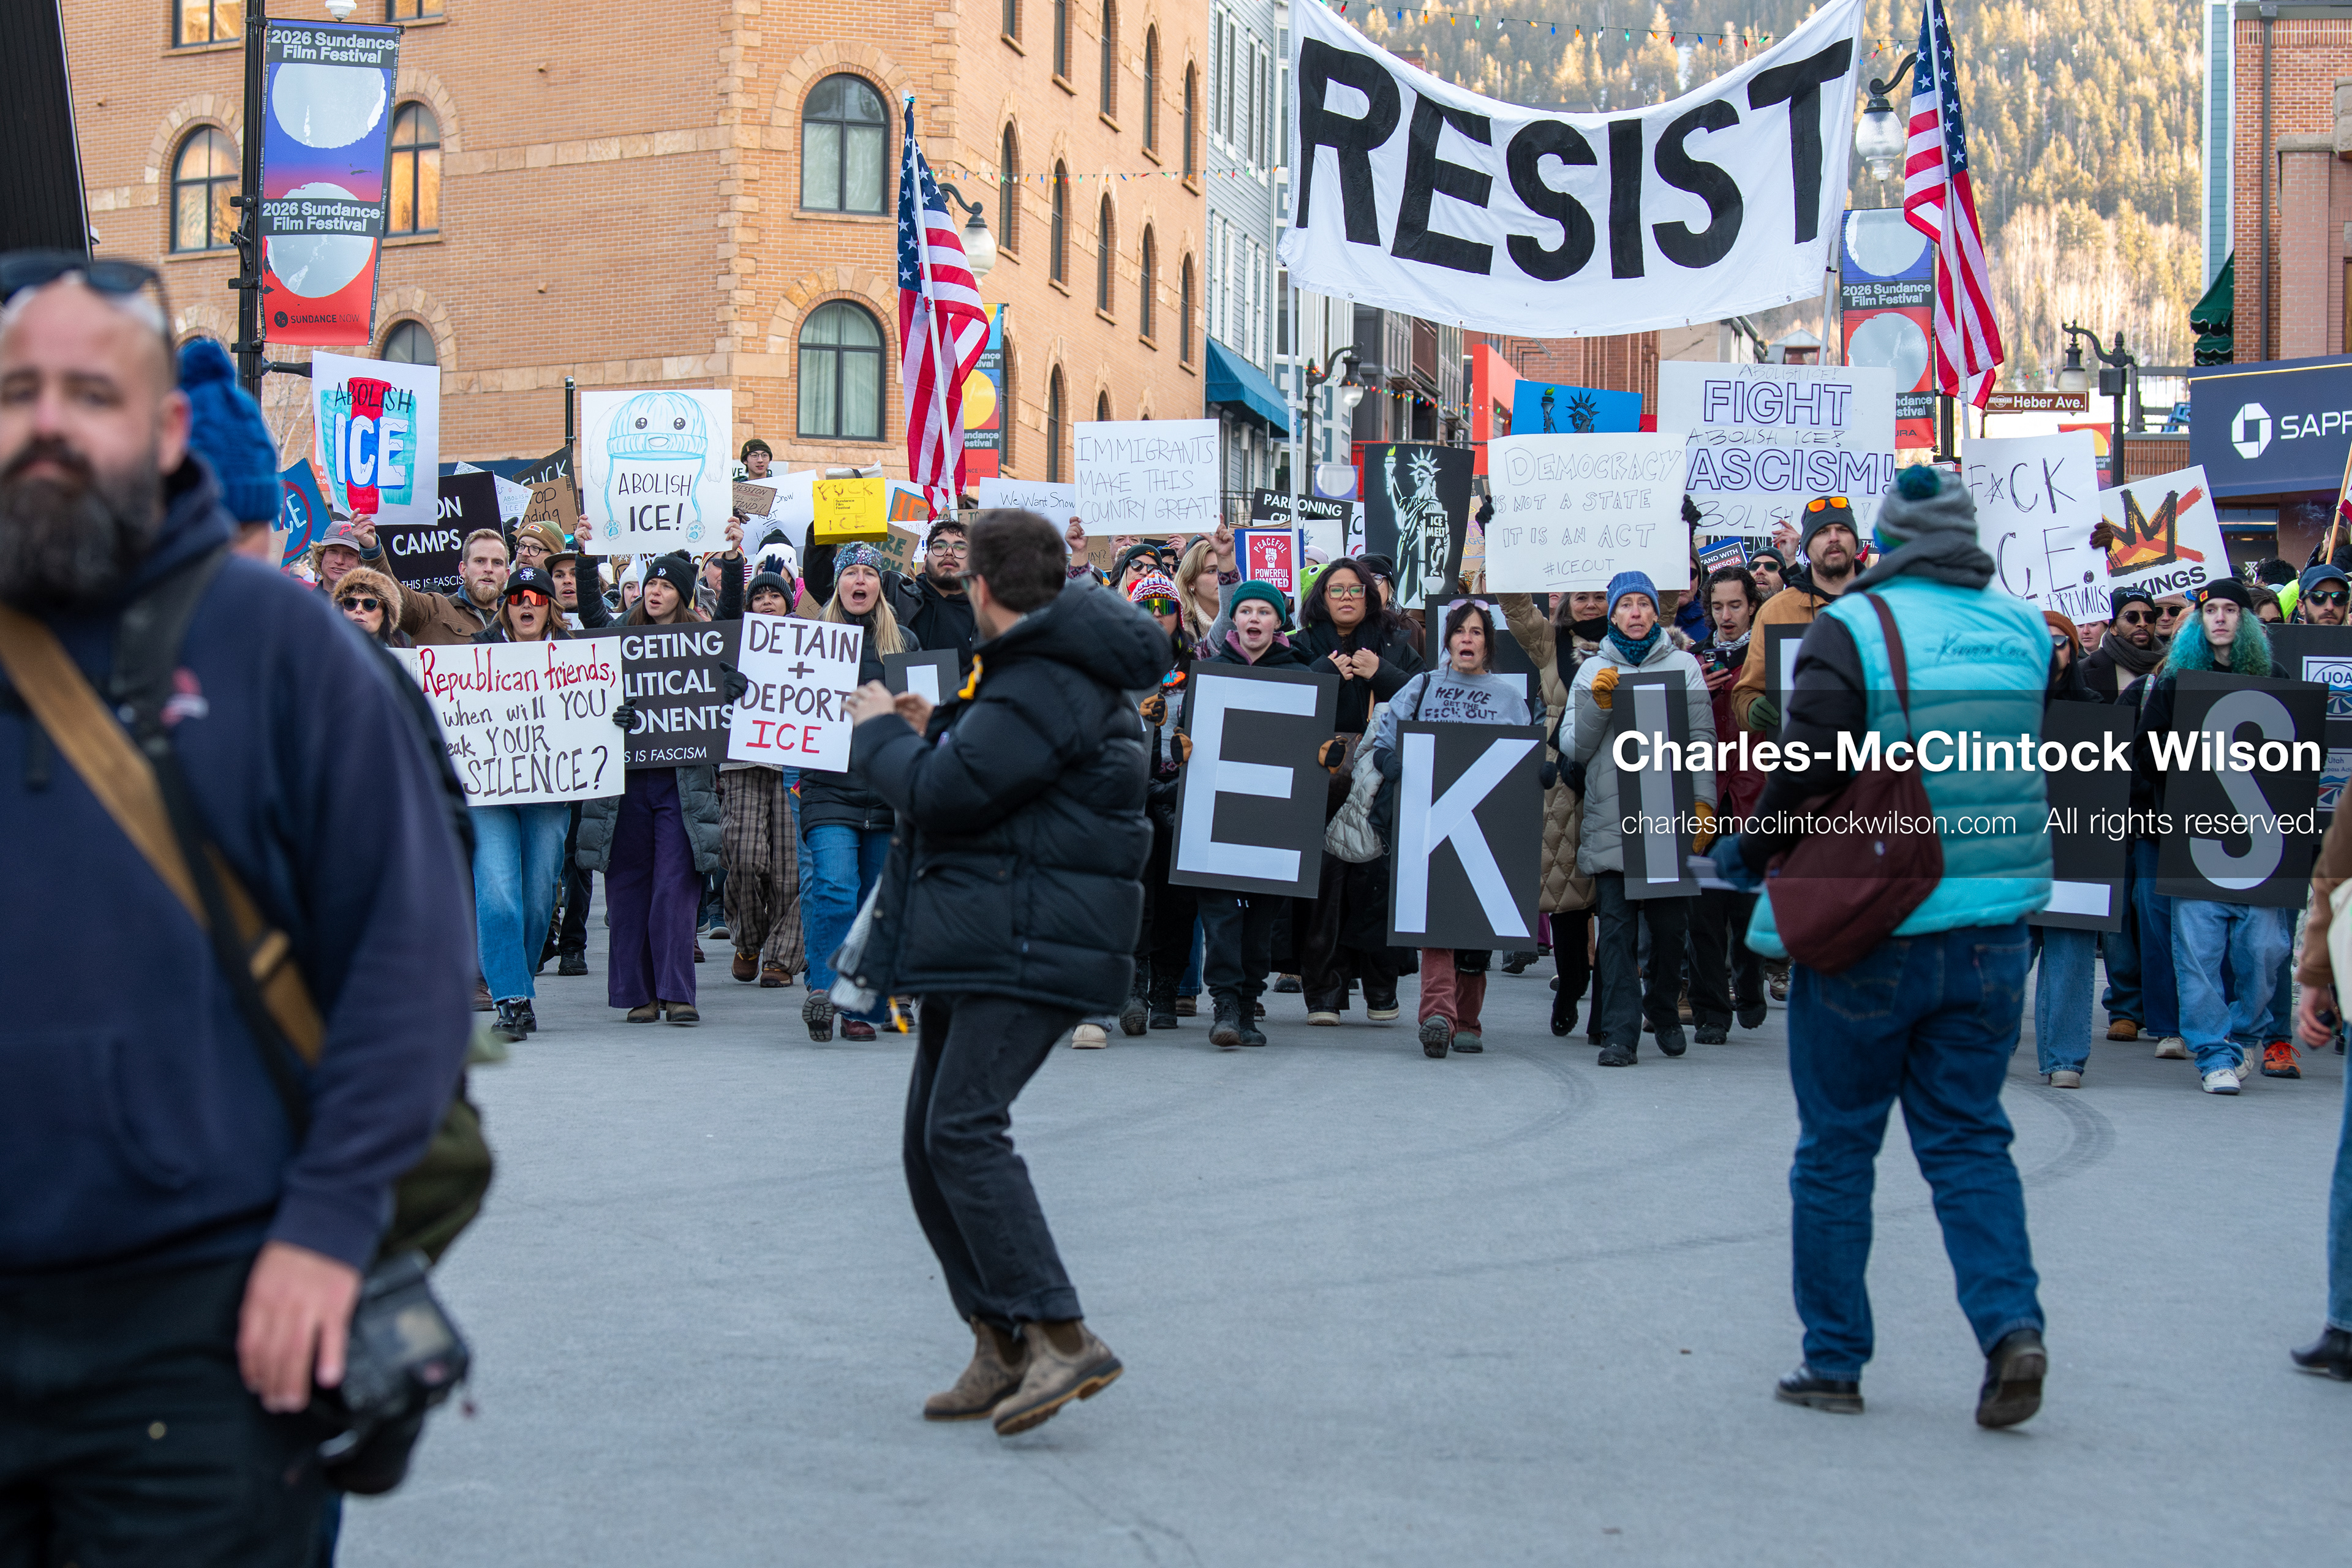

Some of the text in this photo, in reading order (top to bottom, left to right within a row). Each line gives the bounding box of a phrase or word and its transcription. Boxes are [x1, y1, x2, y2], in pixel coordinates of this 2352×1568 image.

[271, 29, 395, 50] 2026 Sundance
[283, 44, 382, 63] Film Festival
[1296, 37, 1853, 282] RESIST
[262, 202, 380, 219] 2026 Sundance
[273, 216, 367, 232] Film Festival
[1842, 284, 1932, 296] 2026 Sundance
[1852, 293, 1923, 306] Film Festival
[291, 314, 360, 323] SUNDANCE NOW
[1738, 364, 1841, 380] ABOLISH ICE!
[335, 381, 413, 413] ABOLISH
[1704, 380, 1852, 426] FIGHT
[2014, 396, 2084, 409] Heber Ave.
[1076, 435, 1215, 464] IMMIGRANTS
[1686, 428, 1845, 448] ABOLISH ICE!
[334, 412, 409, 488] ICE
[1505, 447, 1682, 486] DEMOCRACY
[1686, 448, 1894, 495] ASCISM!
[619, 473, 692, 496] ABOLISH
[817, 481, 873, 501] FUCK
[1080, 469, 1194, 498] MAKE THIS
[503, 494, 529, 503] ABOLISH
[1000, 491, 1075, 508] We Want Snow
[1080, 489, 1217, 524] COUNTRY GREAT!
[1264, 494, 1343, 517] PARONING
[1491, 489, 1651, 513] IS NOT A STATE
[630, 503, 684, 532] ICE!
[829, 514, 865, 531] ICE
[1430, 516, 1443, 527] ICE
[392, 529, 462, 556] CAMPS
[1426, 527, 1446, 538] MELT
[1503, 523, 1656, 548] IT IS AN ACT
[1253, 538, 1287, 554] PEACEFUL
[1719, 548, 1738, 559] WITH
[1256, 568, 1289, 578] POWERFUL
[1542, 559, 1615, 577] #ICEOUT
[1256, 578, 1289, 588] ITED
[2133, 566, 2206, 596] KINGS
[749, 620, 859, 664] DETAIN
[420, 647, 539, 703] Republican
[544, 642, 616, 691] friends,
[788, 662, 815, 679] +
[625, 669, 715, 697] LITICAL
[442, 688, 605, 726] when will YOU
[740, 679, 851, 722] DEPORT
[1435, 687, 1491, 704] HEY ICE
[1463, 702, 1479, 710] THE
[1465, 709, 1498, 720] OUT
[486, 724, 551, 756] YOUR
[746, 719, 822, 754] ICE
[635, 746, 707, 763] IS FASCISM
[463, 745, 608, 797] SILENCE?
[1177, 673, 1318, 881] E
[2189, 690, 2296, 890] S
[1394, 733, 1539, 938] K
